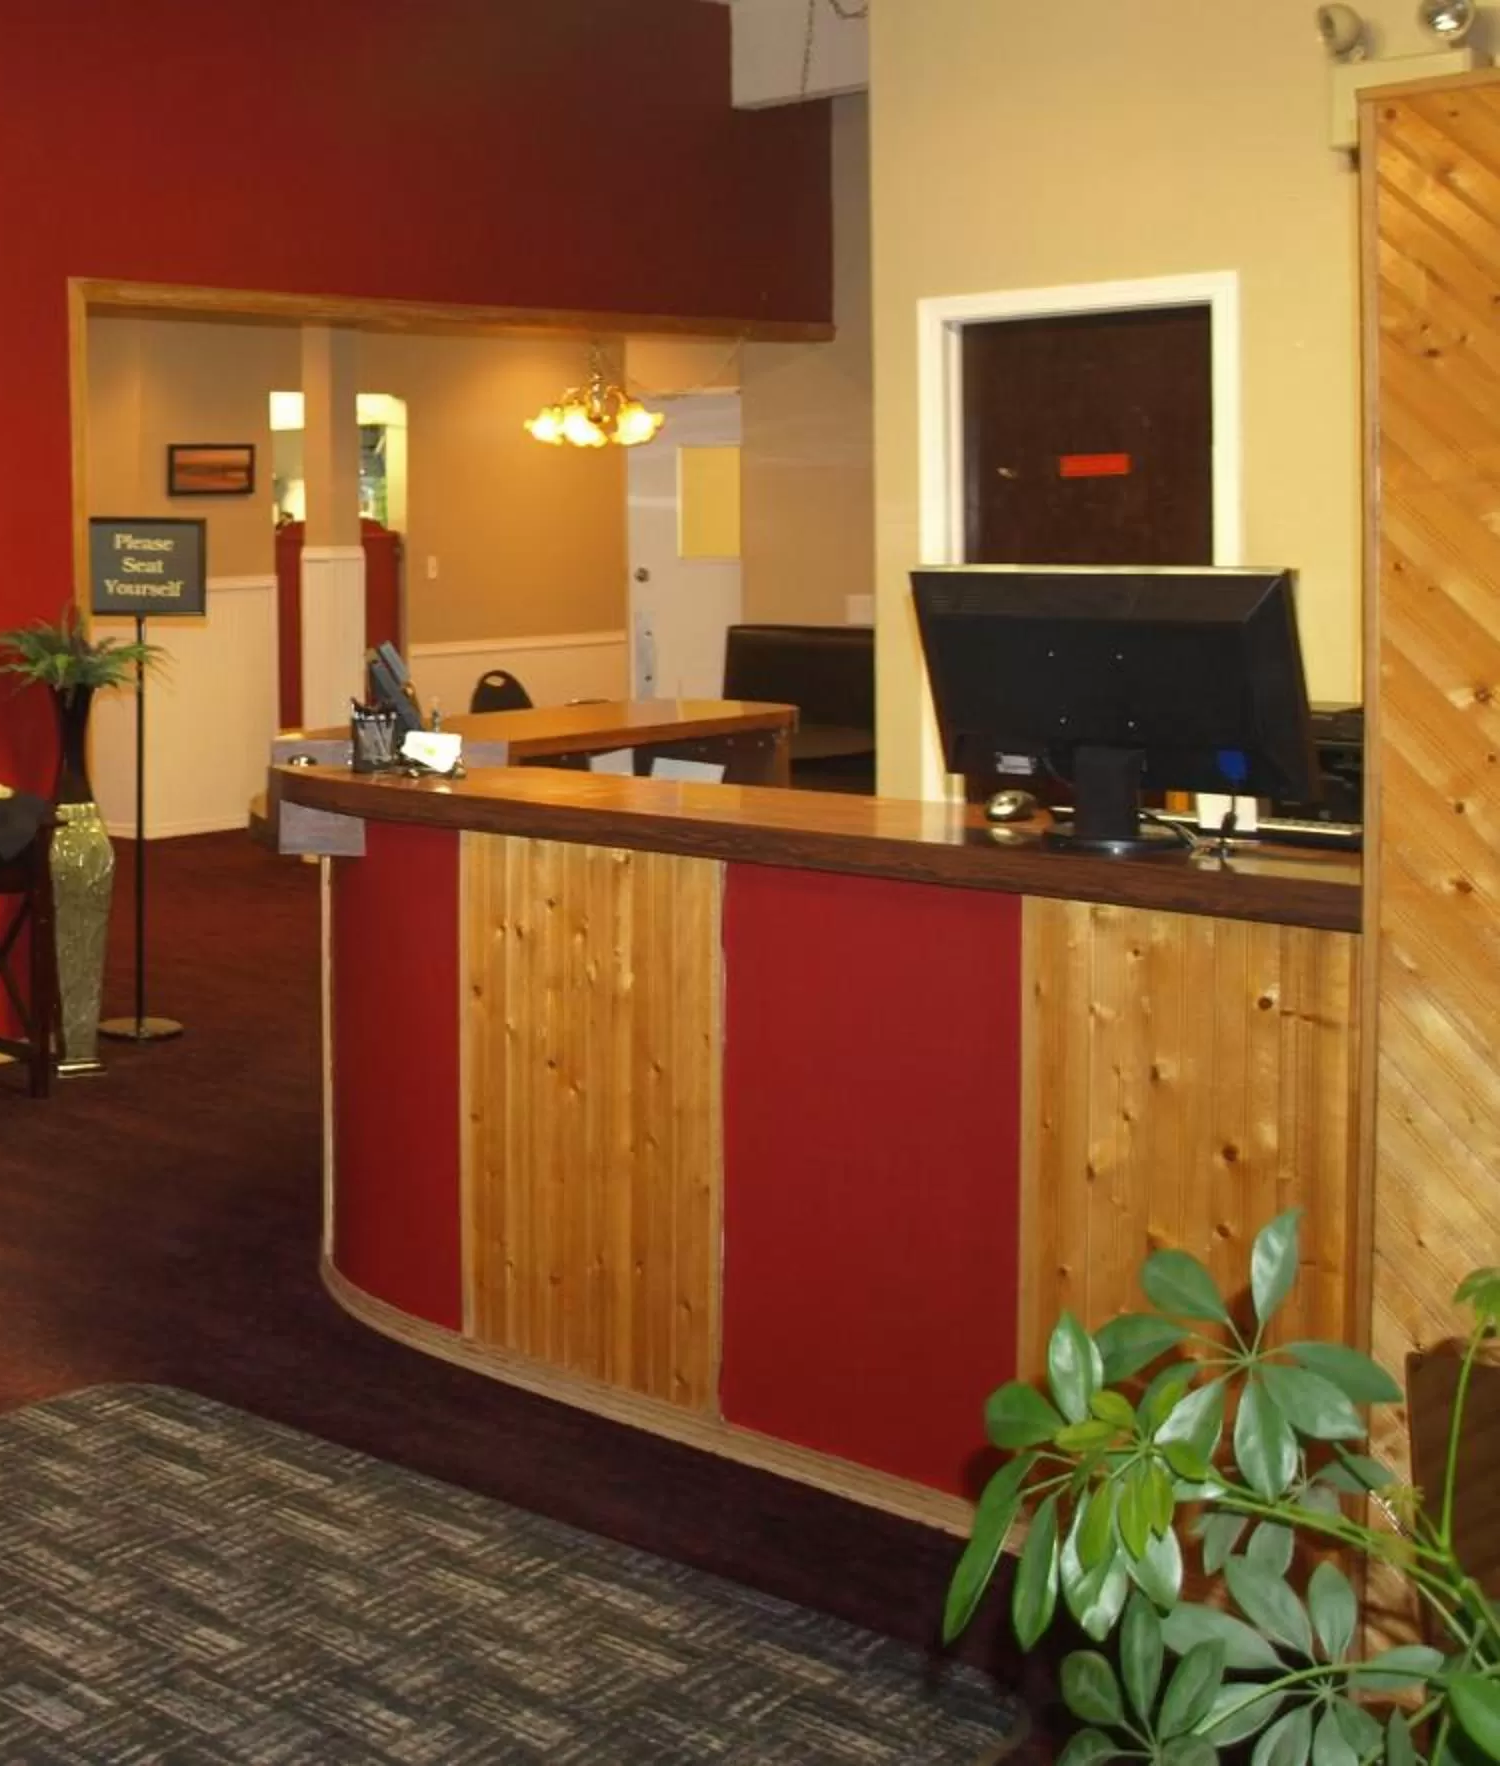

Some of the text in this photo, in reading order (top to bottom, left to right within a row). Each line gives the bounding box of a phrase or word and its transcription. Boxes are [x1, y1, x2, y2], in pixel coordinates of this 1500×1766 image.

[114, 532, 174, 551] Please
[121, 556, 165, 574] Seat
[103, 578, 184, 597] Yourself
